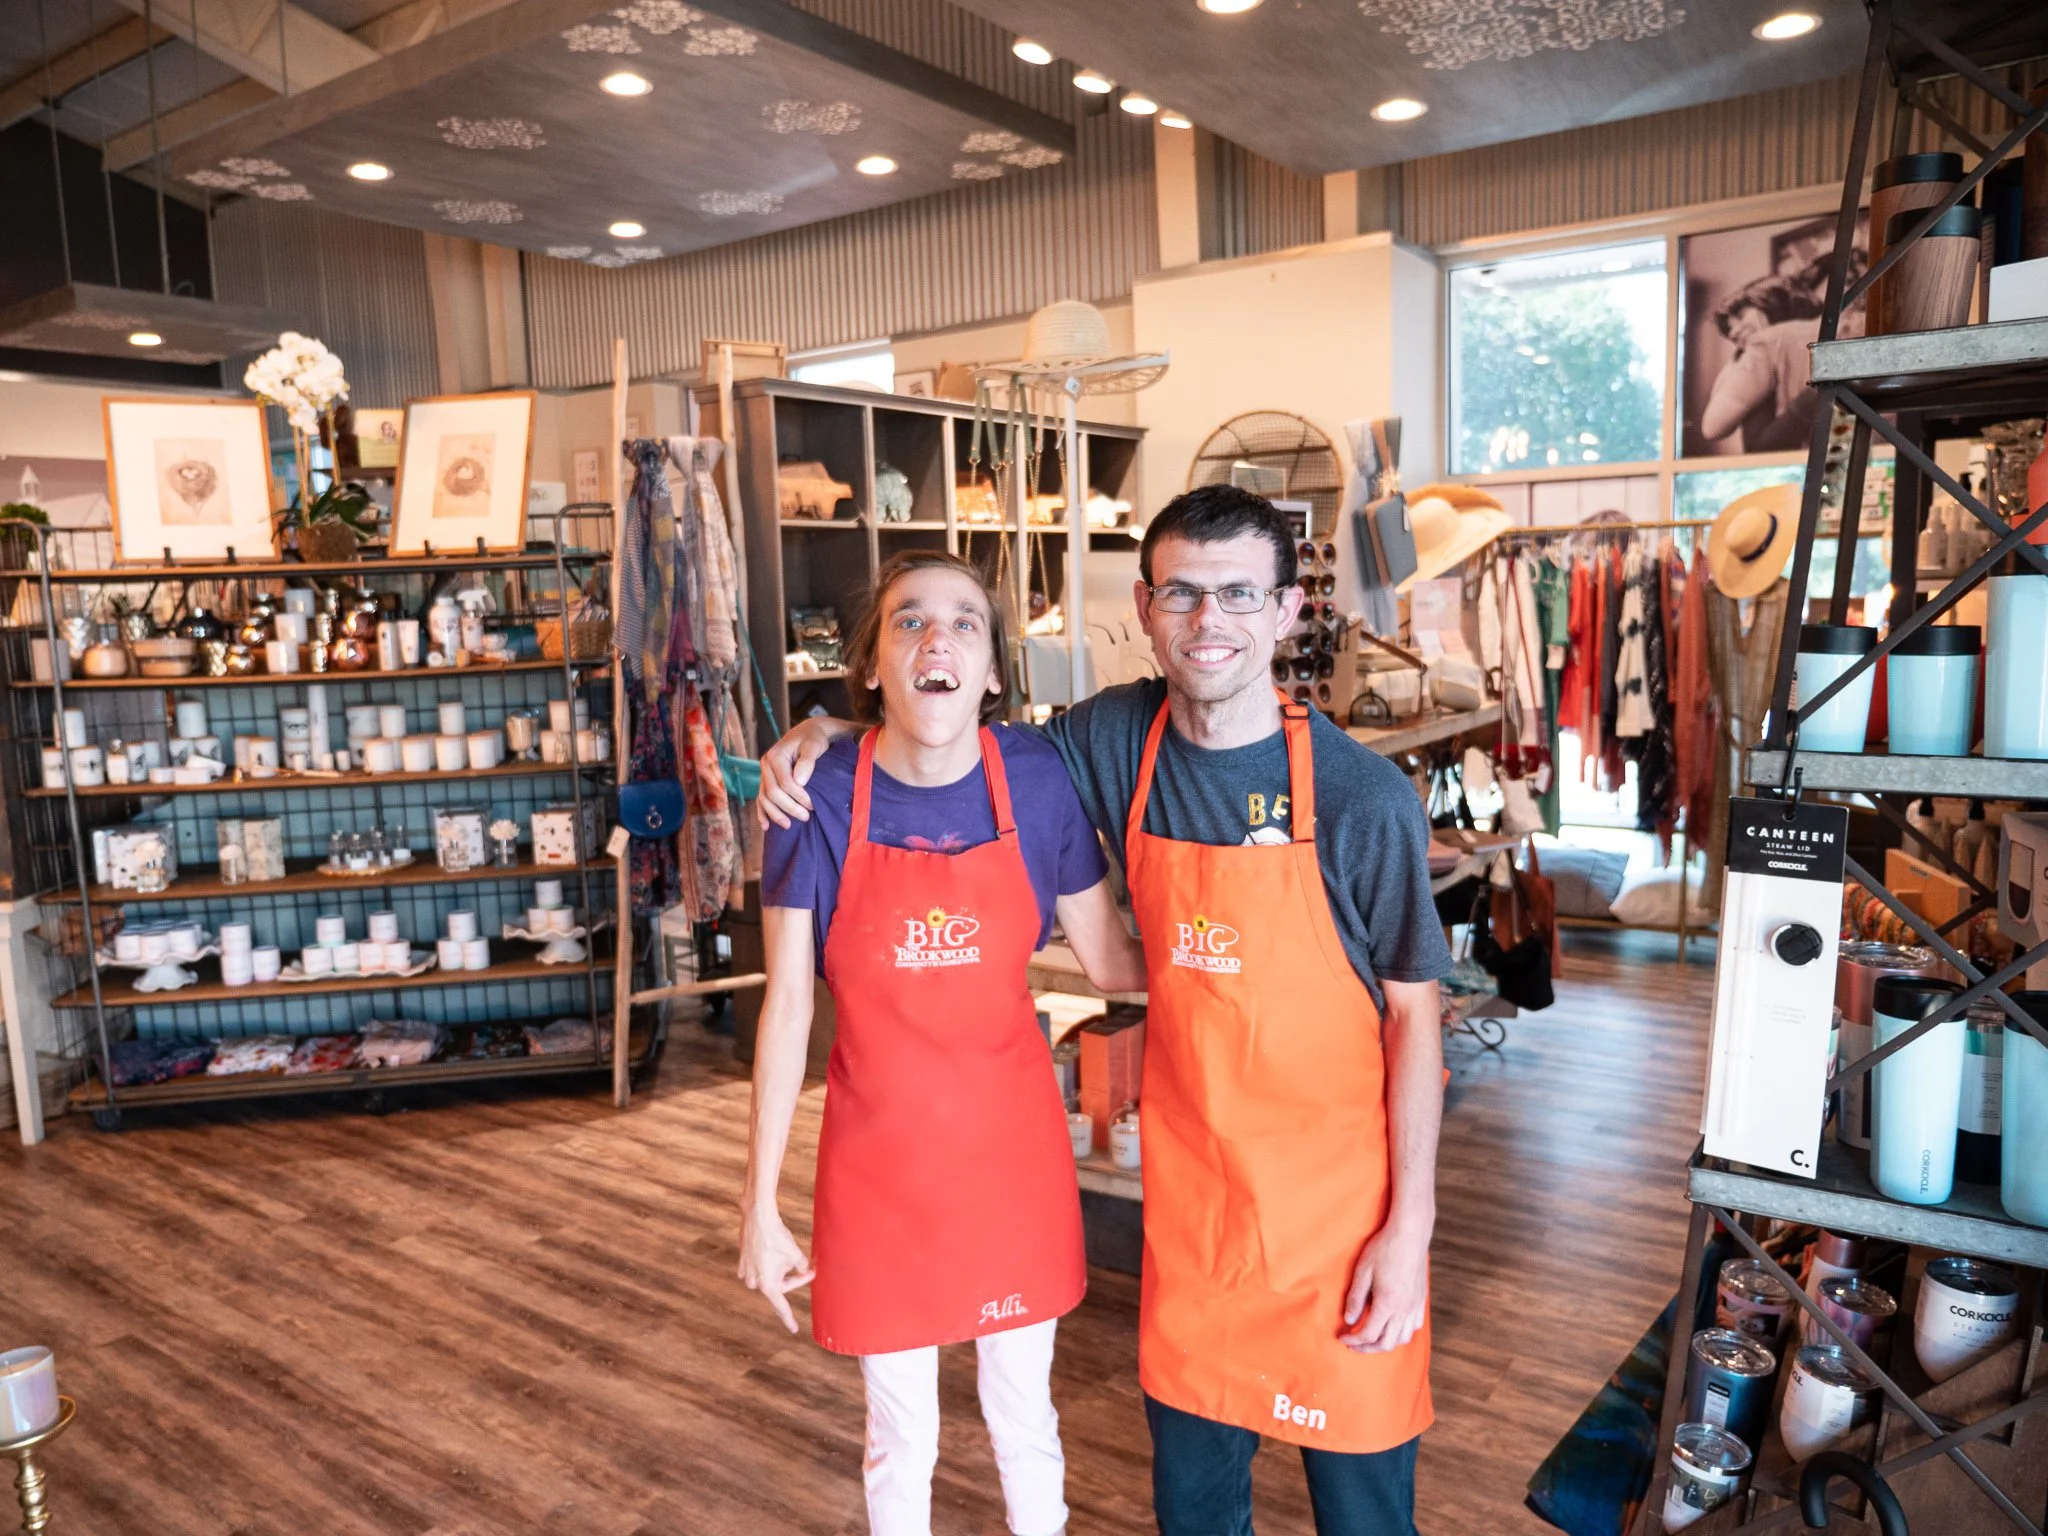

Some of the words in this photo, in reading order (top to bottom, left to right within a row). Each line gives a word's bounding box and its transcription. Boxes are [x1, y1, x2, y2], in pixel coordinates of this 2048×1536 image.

[1746, 826, 1835, 843] CANTEEN
[1765, 842, 1793, 850] STRAW
[896, 946, 980, 961] BROOKWOOD
[1170, 948, 1242, 968] BROOKWOOD
[1273, 1393, 1327, 1431] Ben
